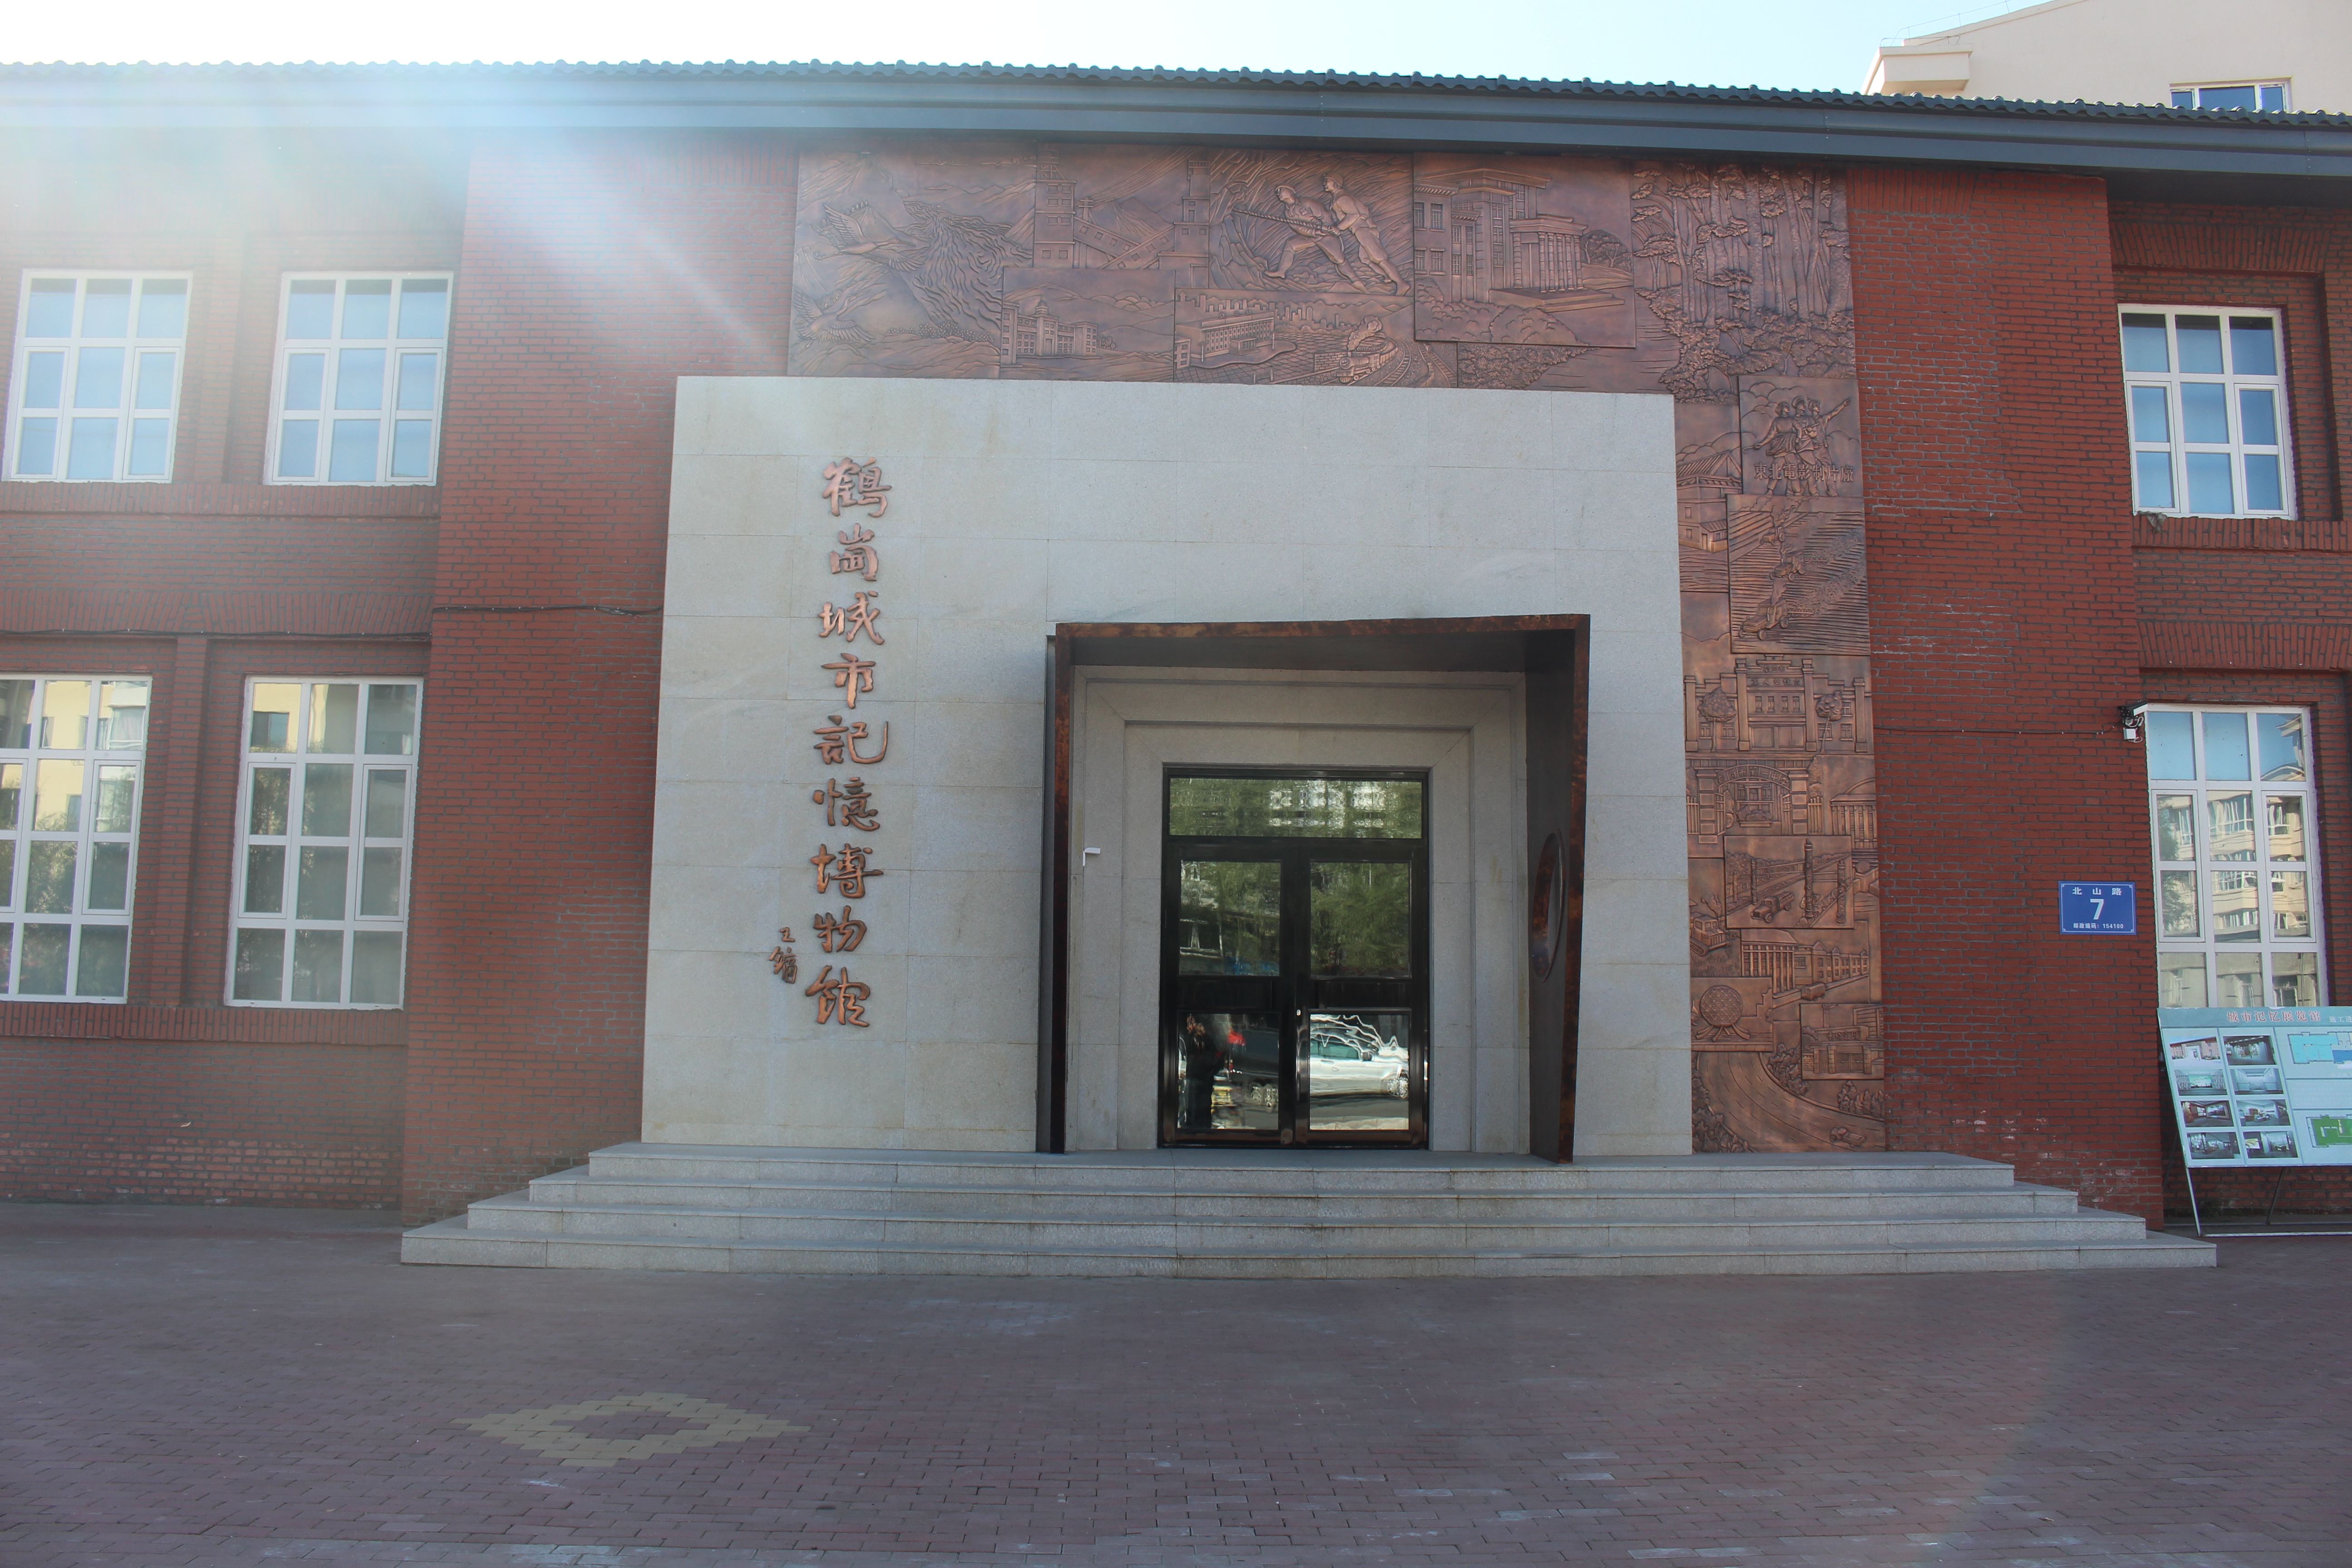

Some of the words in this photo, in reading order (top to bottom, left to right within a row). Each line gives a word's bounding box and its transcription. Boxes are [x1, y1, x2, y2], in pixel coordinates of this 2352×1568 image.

[2072, 887, 2122, 896] 北山路
[2090, 898, 2104, 920] 7
[2227, 1010, 2321, 1022] 城市记忆展览馆
